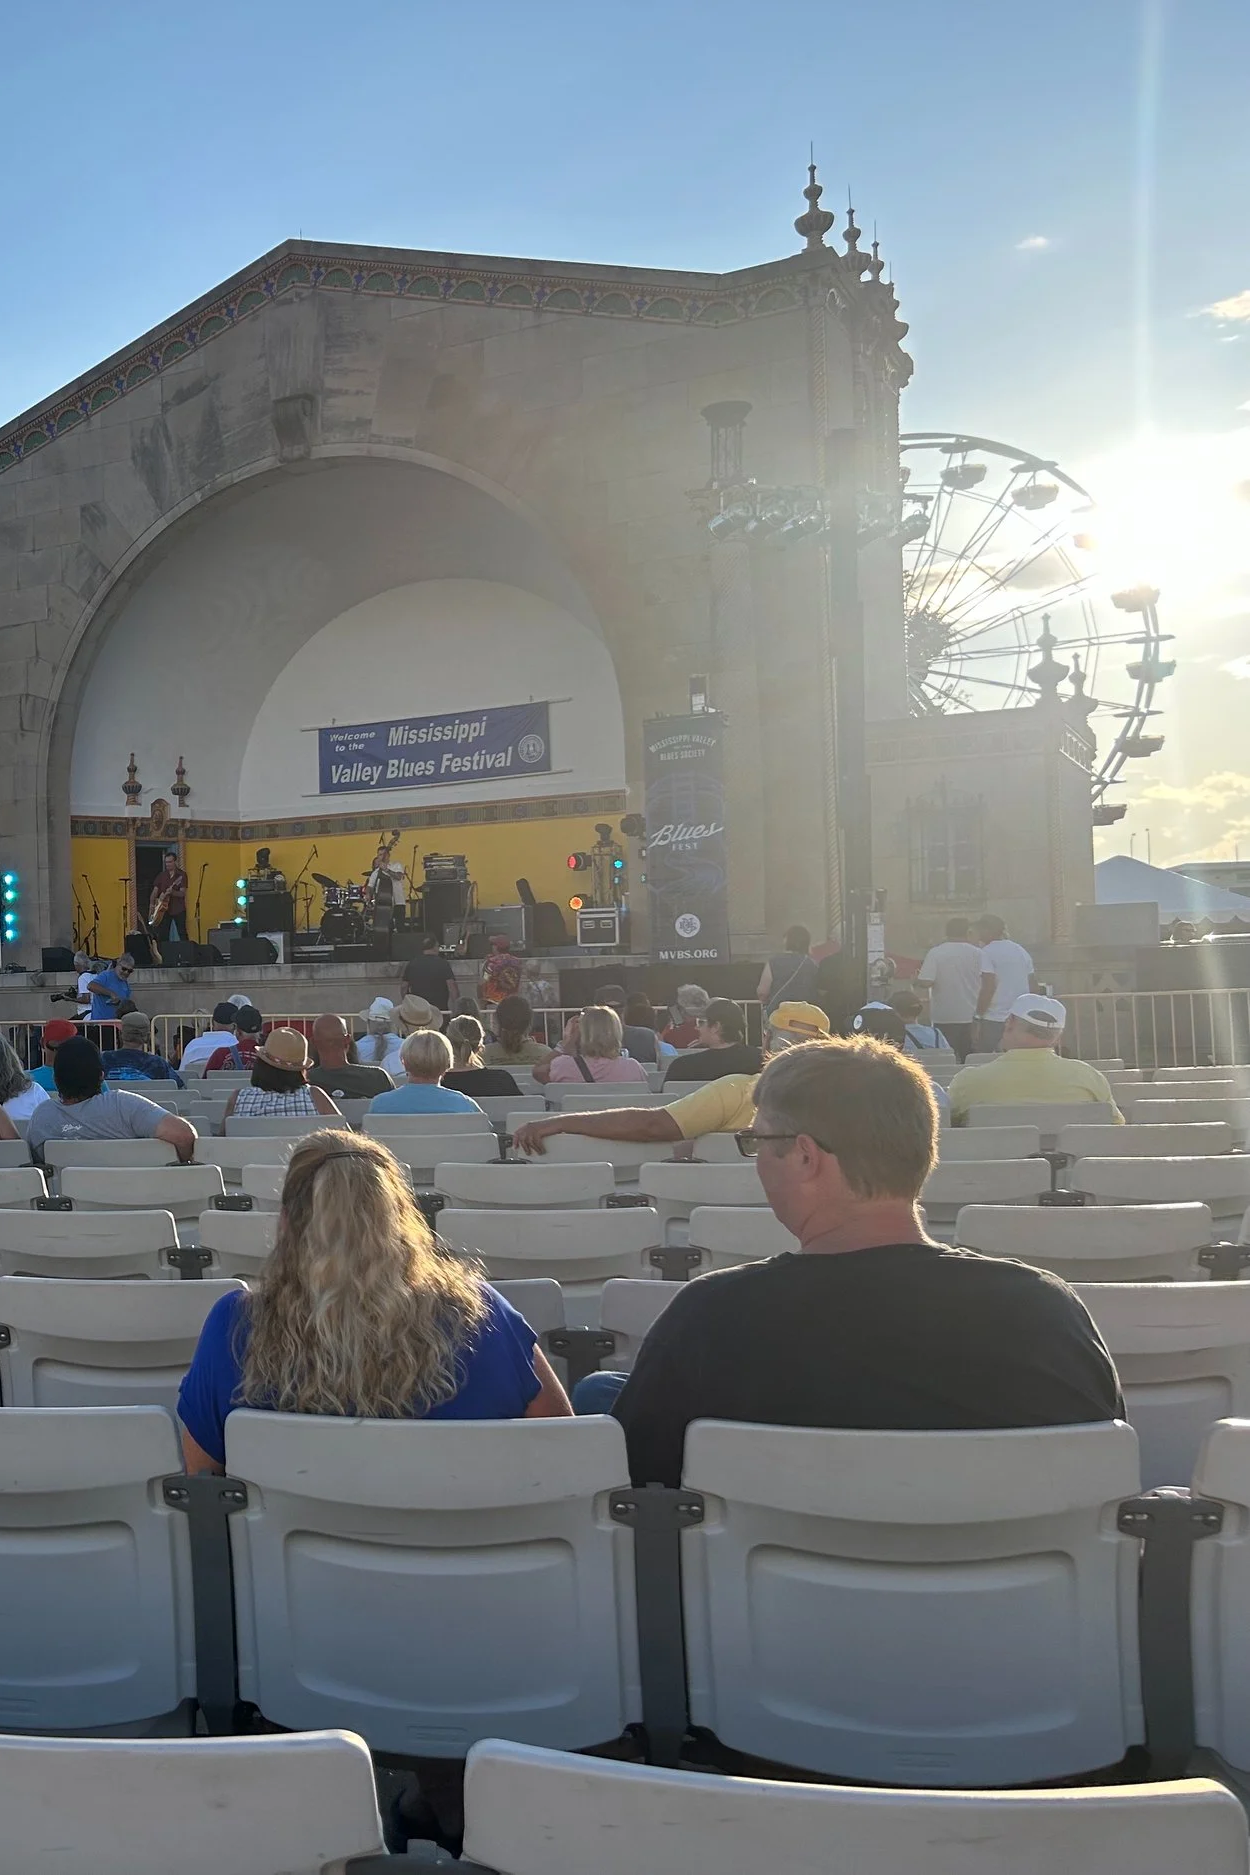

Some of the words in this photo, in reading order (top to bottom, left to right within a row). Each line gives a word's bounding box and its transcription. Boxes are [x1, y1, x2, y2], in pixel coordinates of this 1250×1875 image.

[329, 730, 376, 742] Welcome
[388, 716, 488, 747] Mississippi
[335, 743, 346, 752] to
[348, 742, 365, 752] the
[648, 734, 690, 753] MISSISSIPPI
[692, 735, 717, 747] VALLEY
[660, 751, 678, 761] BLUES
[680, 749, 706, 759] SOCIETY
[331, 762, 382, 786] Valley
[386, 758, 435, 779] Blues
[440, 746, 513, 774] Festival
[648, 821, 724, 848] Blues
[672, 842, 699, 852] FEST
[659, 948, 718, 960] MVBS.ORG
